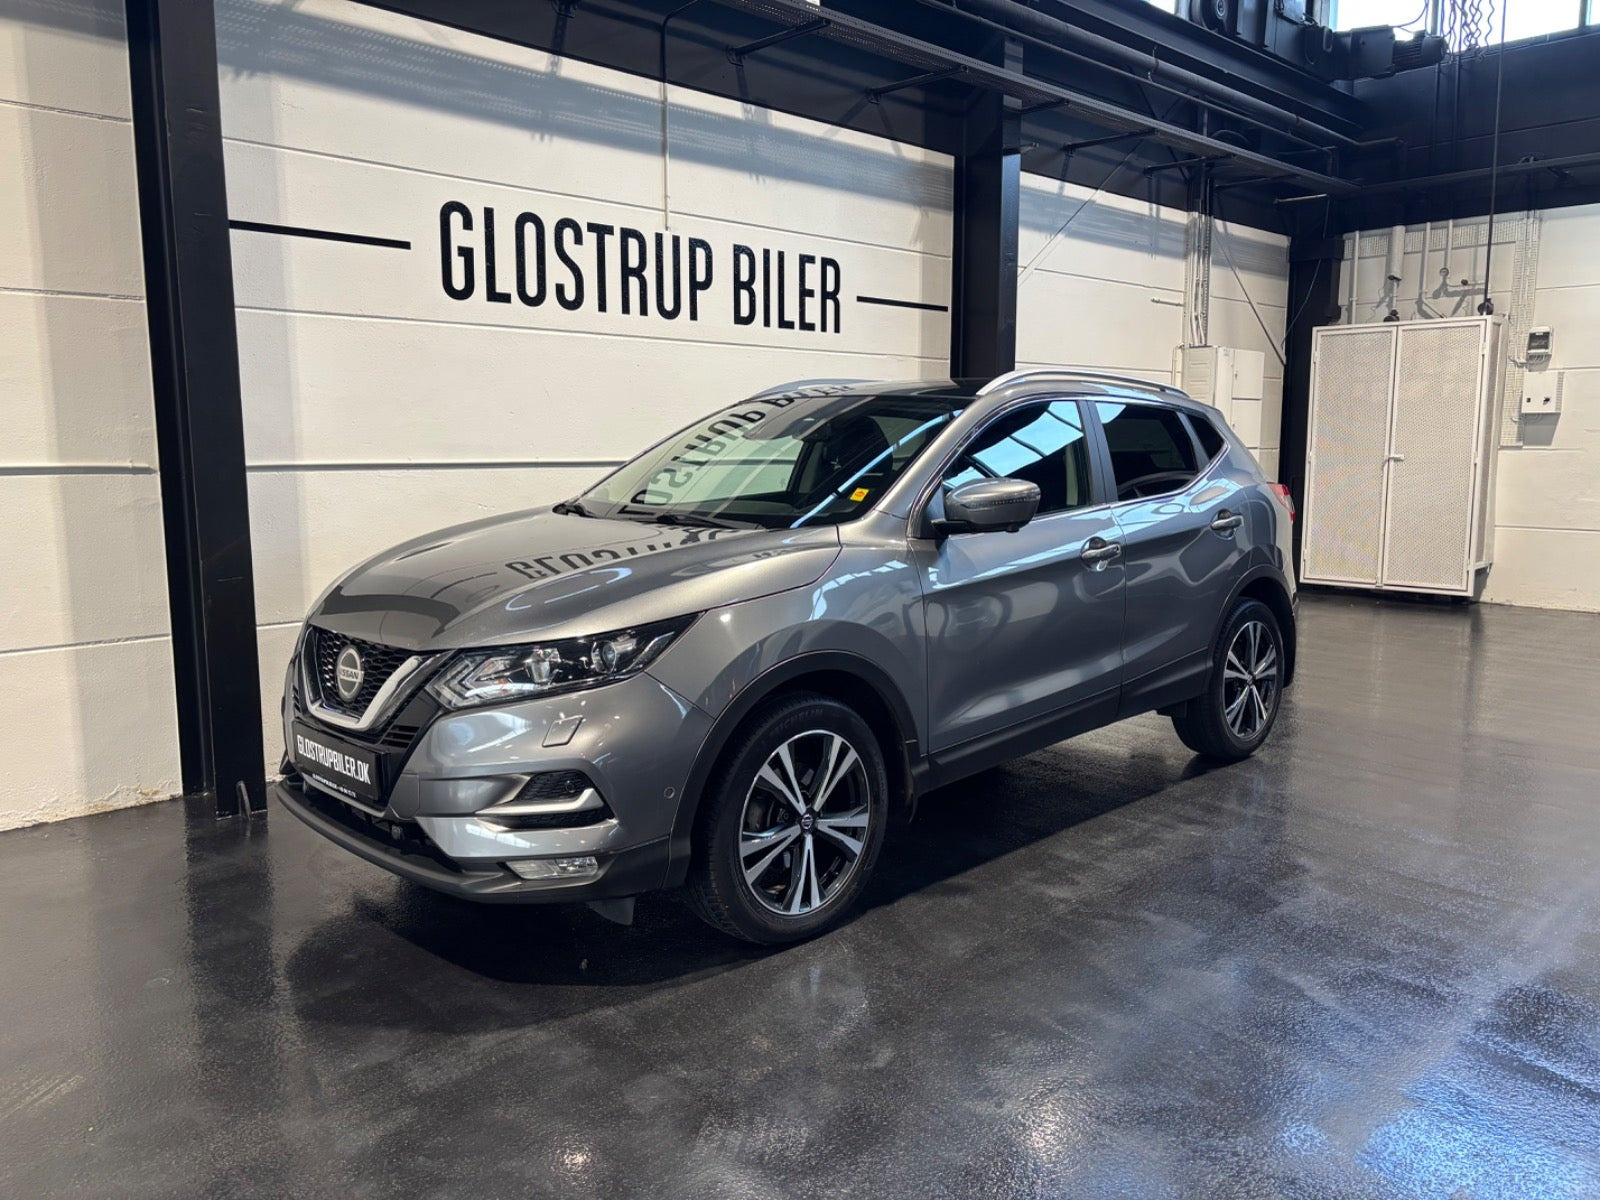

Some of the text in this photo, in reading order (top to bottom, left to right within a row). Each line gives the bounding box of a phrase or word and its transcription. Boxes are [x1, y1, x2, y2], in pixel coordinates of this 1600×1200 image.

[440, 201, 840, 333] GLOSTRUP BILER
[297, 734, 371, 785] GLOSTRUPBILER.DK
